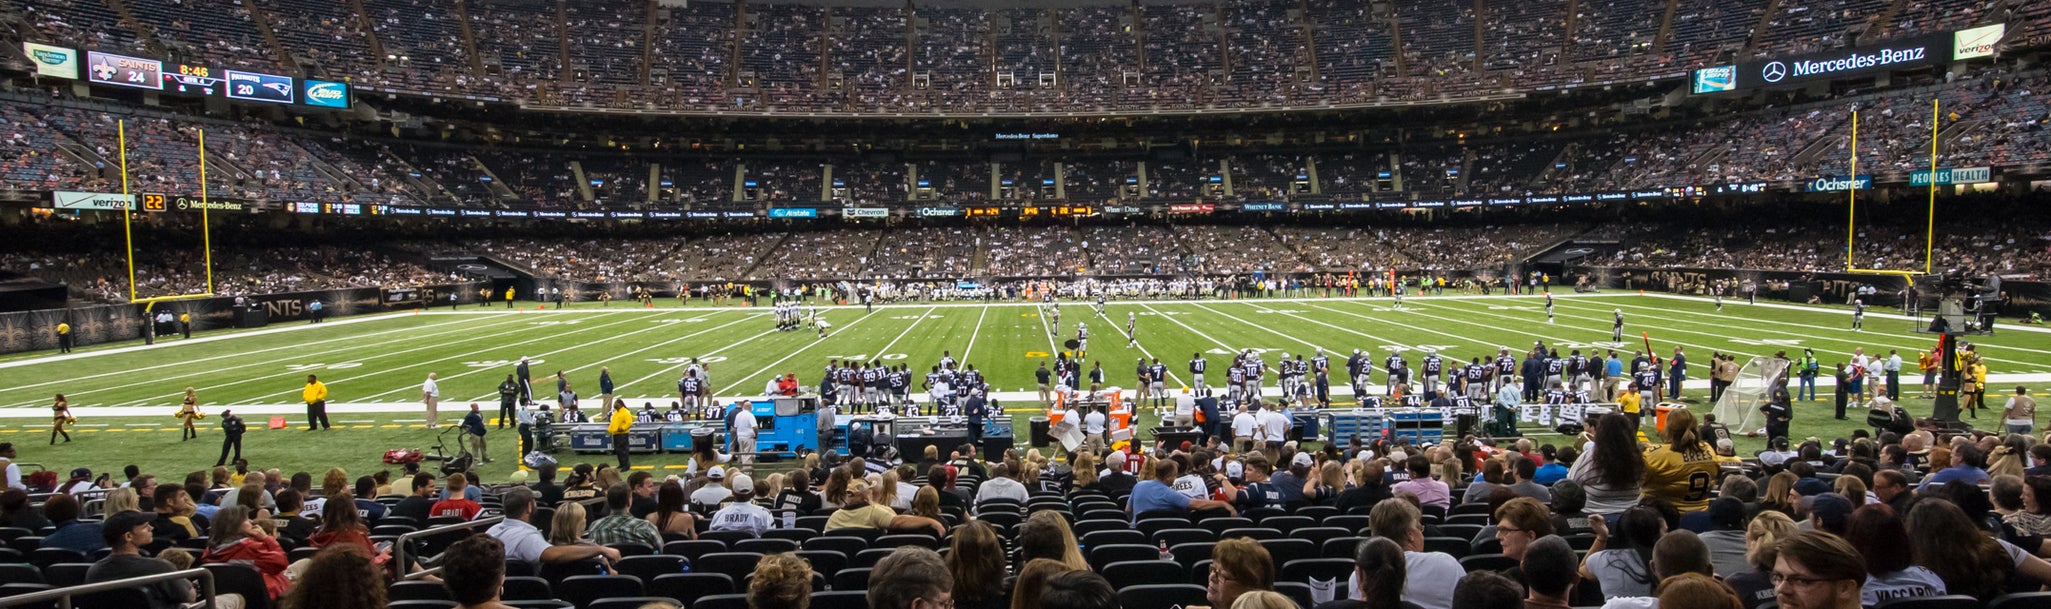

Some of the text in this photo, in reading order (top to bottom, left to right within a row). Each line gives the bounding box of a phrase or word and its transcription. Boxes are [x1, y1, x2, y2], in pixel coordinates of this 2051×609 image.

[119, 60, 157, 72] SAINTS
[1793, 47, 1925, 77] Mercedes-Benz
[180, 64, 209, 77] 8:46
[128, 71, 146, 83] 24
[238, 84, 254, 95] 20
[1953, 169, 1988, 181] HEALTH
[1815, 178, 1865, 191] Ochsner
[93, 197, 132, 209] verizon
[146, 195, 163, 210] 22
[1268, 202, 1283, 210] BANK
[857, 208, 885, 216] Chevron
[922, 207, 956, 217] Ochsner
[1194, 362, 1204, 371] 41
[1315, 359, 1327, 370] 47
[1501, 362, 1514, 372] 72
[864, 372, 876, 382] 99
[1154, 369, 1161, 379] 7
[1246, 366, 1258, 377] 10
[1468, 369, 1483, 380] 69
[684, 381, 698, 392] 95
[889, 377, 903, 388] 55
[1641, 376, 1655, 387] 49
[1407, 397, 1421, 406] 44
[1548, 394, 1564, 404] 77
[706, 408, 721, 419] 97
[906, 407, 919, 417] 43
[945, 408, 959, 417] 27
[1682, 449, 1713, 462] BREES
[1130, 460, 1139, 473] 11
[1393, 473, 1411, 481] BRAD
[1683, 470, 1711, 501] 9
[784, 494, 803, 504] BREES
[441, 508, 463, 517] BRADY
[724, 513, 750, 523] BRADY
[1875, 586, 1935, 601] VACCARO
